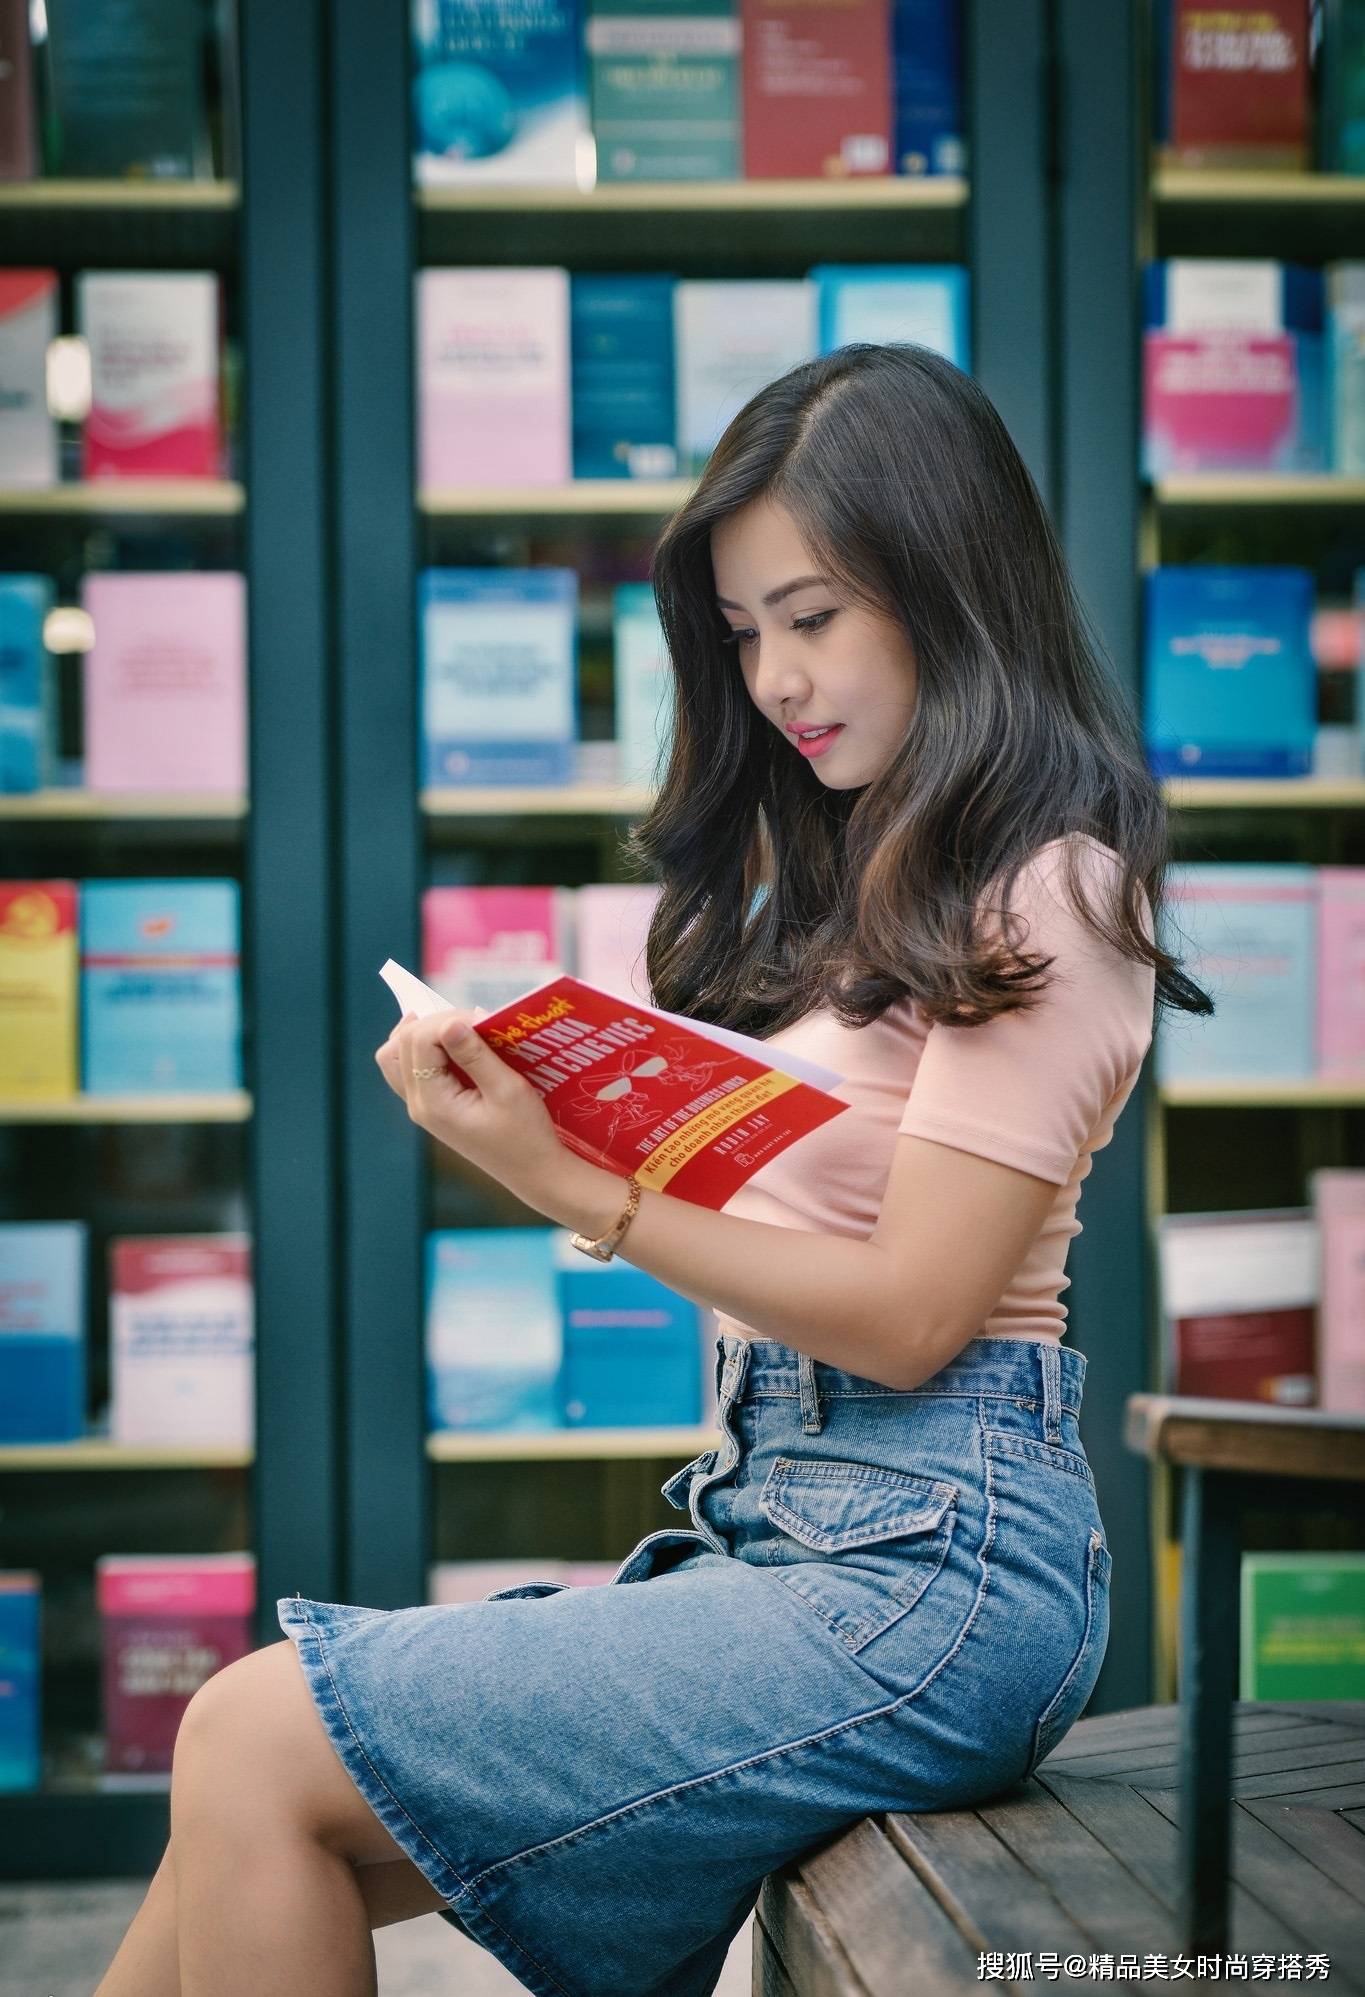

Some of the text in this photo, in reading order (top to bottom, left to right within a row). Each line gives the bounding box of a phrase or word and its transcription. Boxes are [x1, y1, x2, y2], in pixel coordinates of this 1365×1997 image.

[550, 1038, 616, 1073] CÔNG
[594, 1017, 656, 1047] VIỆC
[635, 1137, 658, 1155] THE
[649, 1125, 670, 1142] ART
[662, 1118, 680, 1130] OF
[671, 1108, 694, 1123] THE
[684, 1087, 726, 1114] BUSINESS
[644, 1153, 668, 1174] Kiến
[663, 1140, 681, 1154] tạo
[679, 1119, 710, 1141] những
[670, 1152, 686, 1167] cho
[684, 1129, 712, 1152] doanh
[713, 1128, 750, 1155] ROBIN
[747, 1113, 770, 1129] JAY
